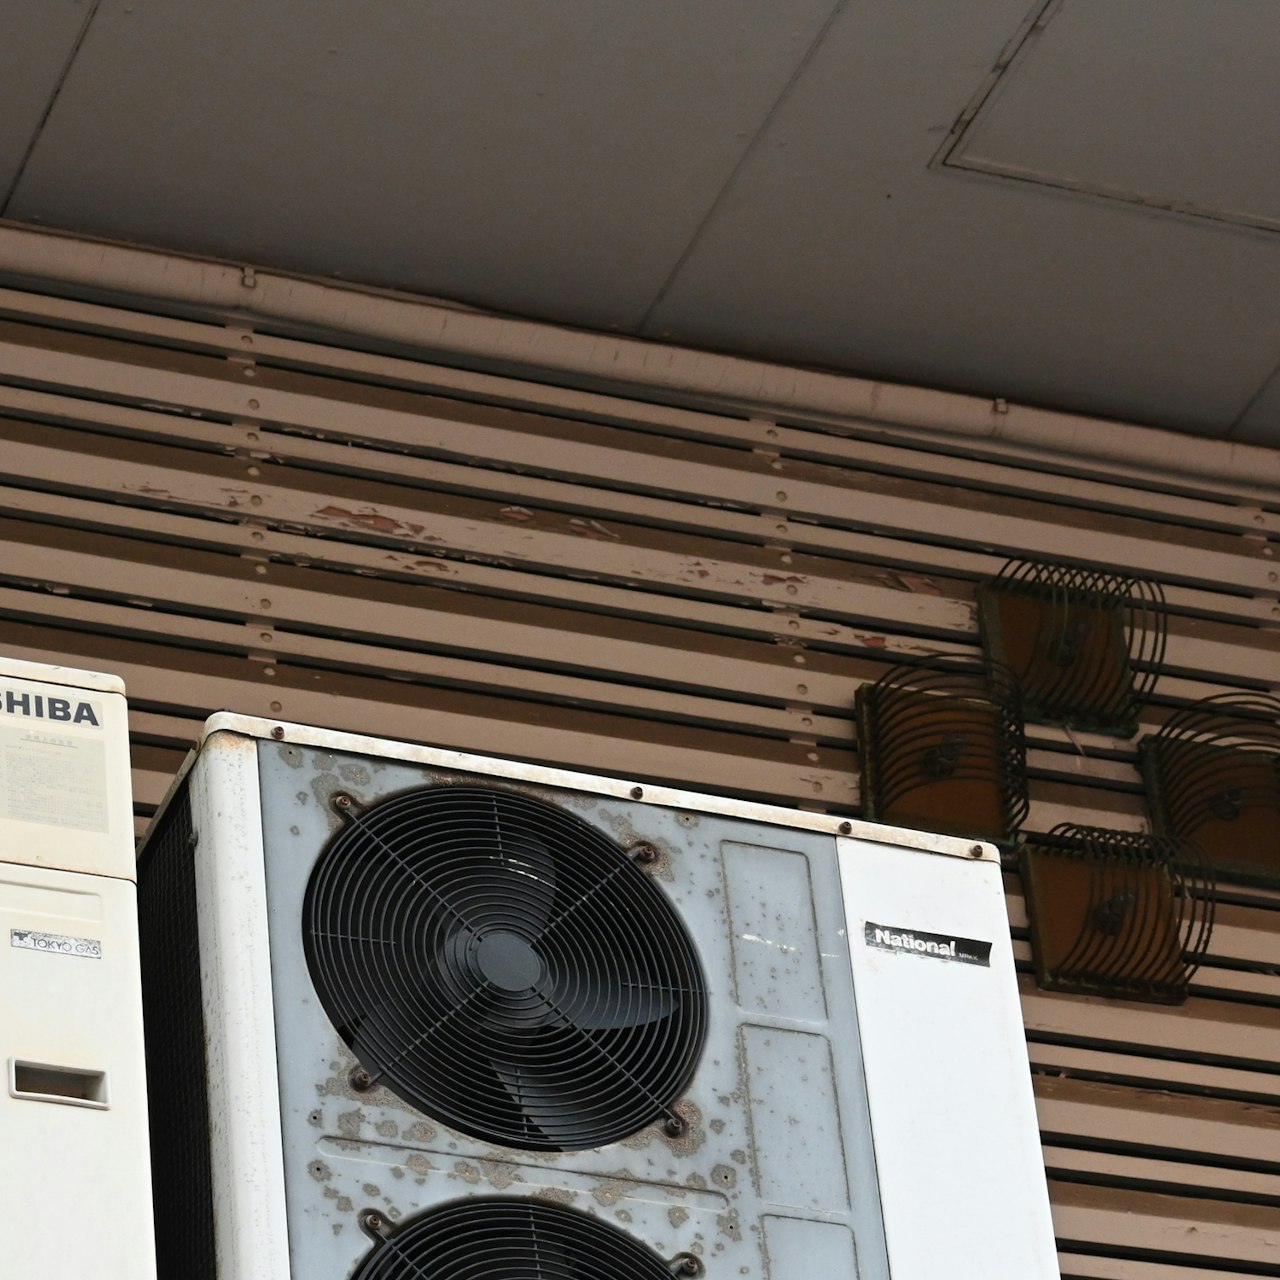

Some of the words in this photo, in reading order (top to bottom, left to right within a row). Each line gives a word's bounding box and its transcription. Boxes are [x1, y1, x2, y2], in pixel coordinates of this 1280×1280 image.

[32, 938, 73, 953] TOKYO
[74, 943, 100, 956] GAS
[874, 927, 957, 957] National
